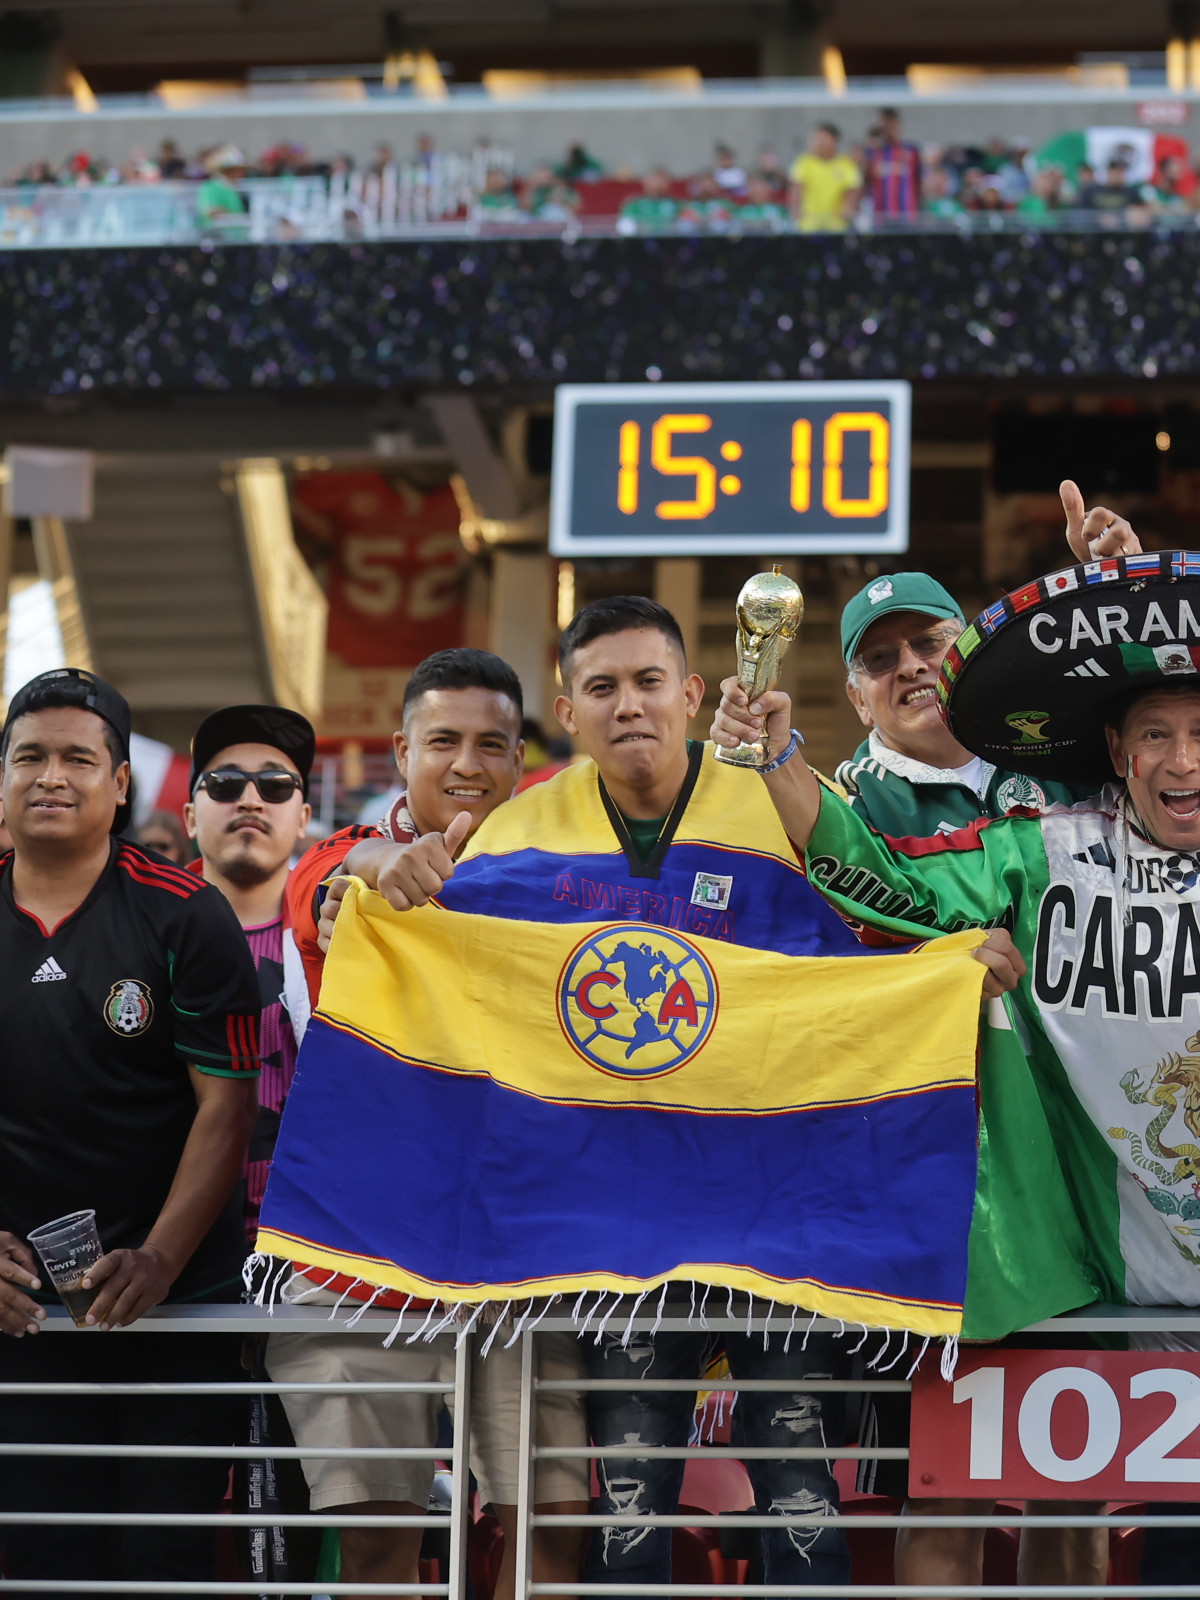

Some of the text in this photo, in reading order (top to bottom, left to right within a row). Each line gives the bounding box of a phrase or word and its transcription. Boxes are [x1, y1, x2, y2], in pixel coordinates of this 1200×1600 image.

[344, 533, 467, 621] 52
[984, 739, 1077, 751] FIFA WORLD CUP
[552, 873, 738, 946] AMERICA
[31, 972, 67, 983] adidas
[249, 1467, 262, 1509] Goodfellas
[251, 1532, 265, 1574] Goodfellas
